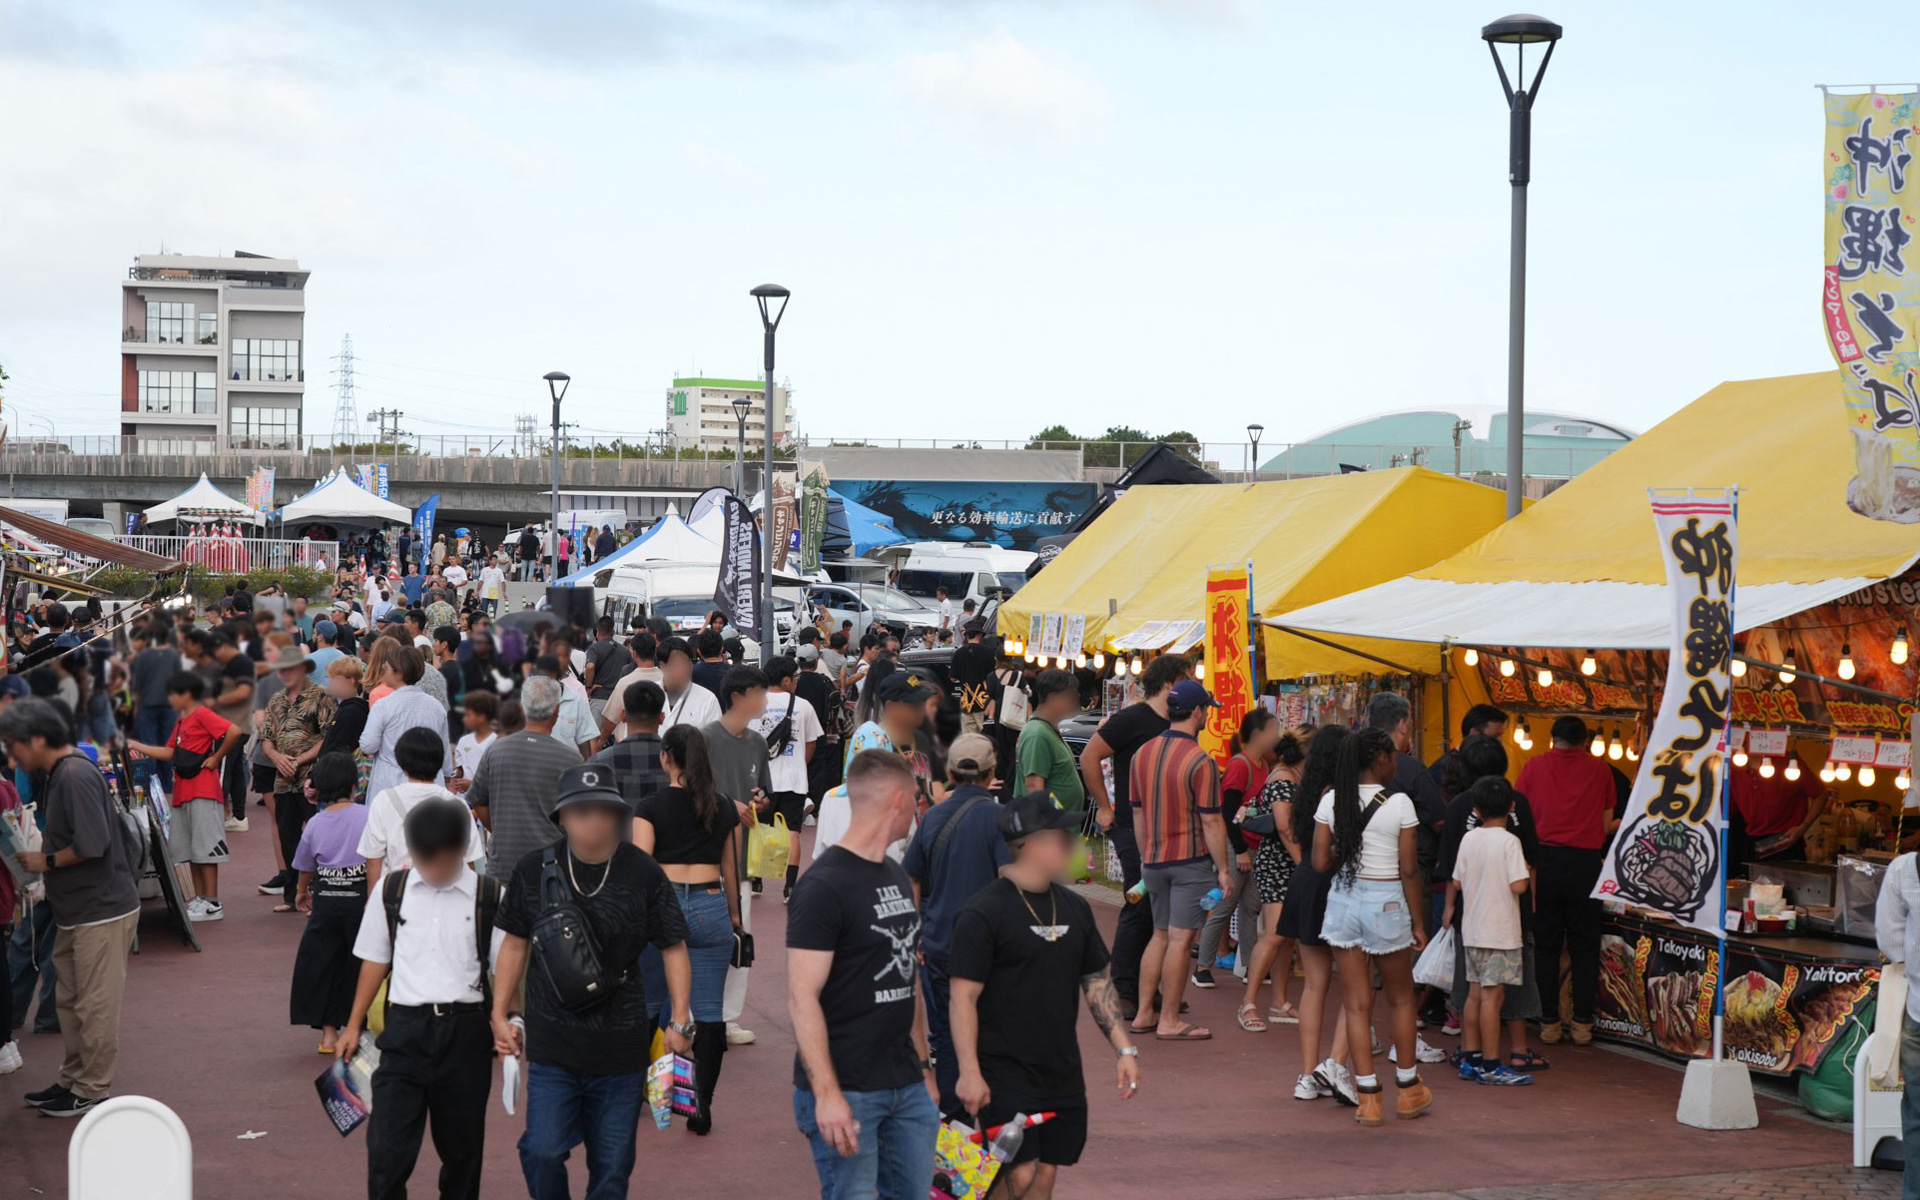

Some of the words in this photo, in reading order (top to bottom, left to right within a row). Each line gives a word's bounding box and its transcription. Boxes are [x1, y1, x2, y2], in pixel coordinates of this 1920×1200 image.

[930, 511, 1082, 525] 更なる効率輸送に貢献す
[347, 863, 367, 876] SPO
[1658, 938, 1706, 961] Takoyaki
[1804, 966, 1864, 984] Yakitori
[1727, 1045, 1778, 1068] Yakisoba
